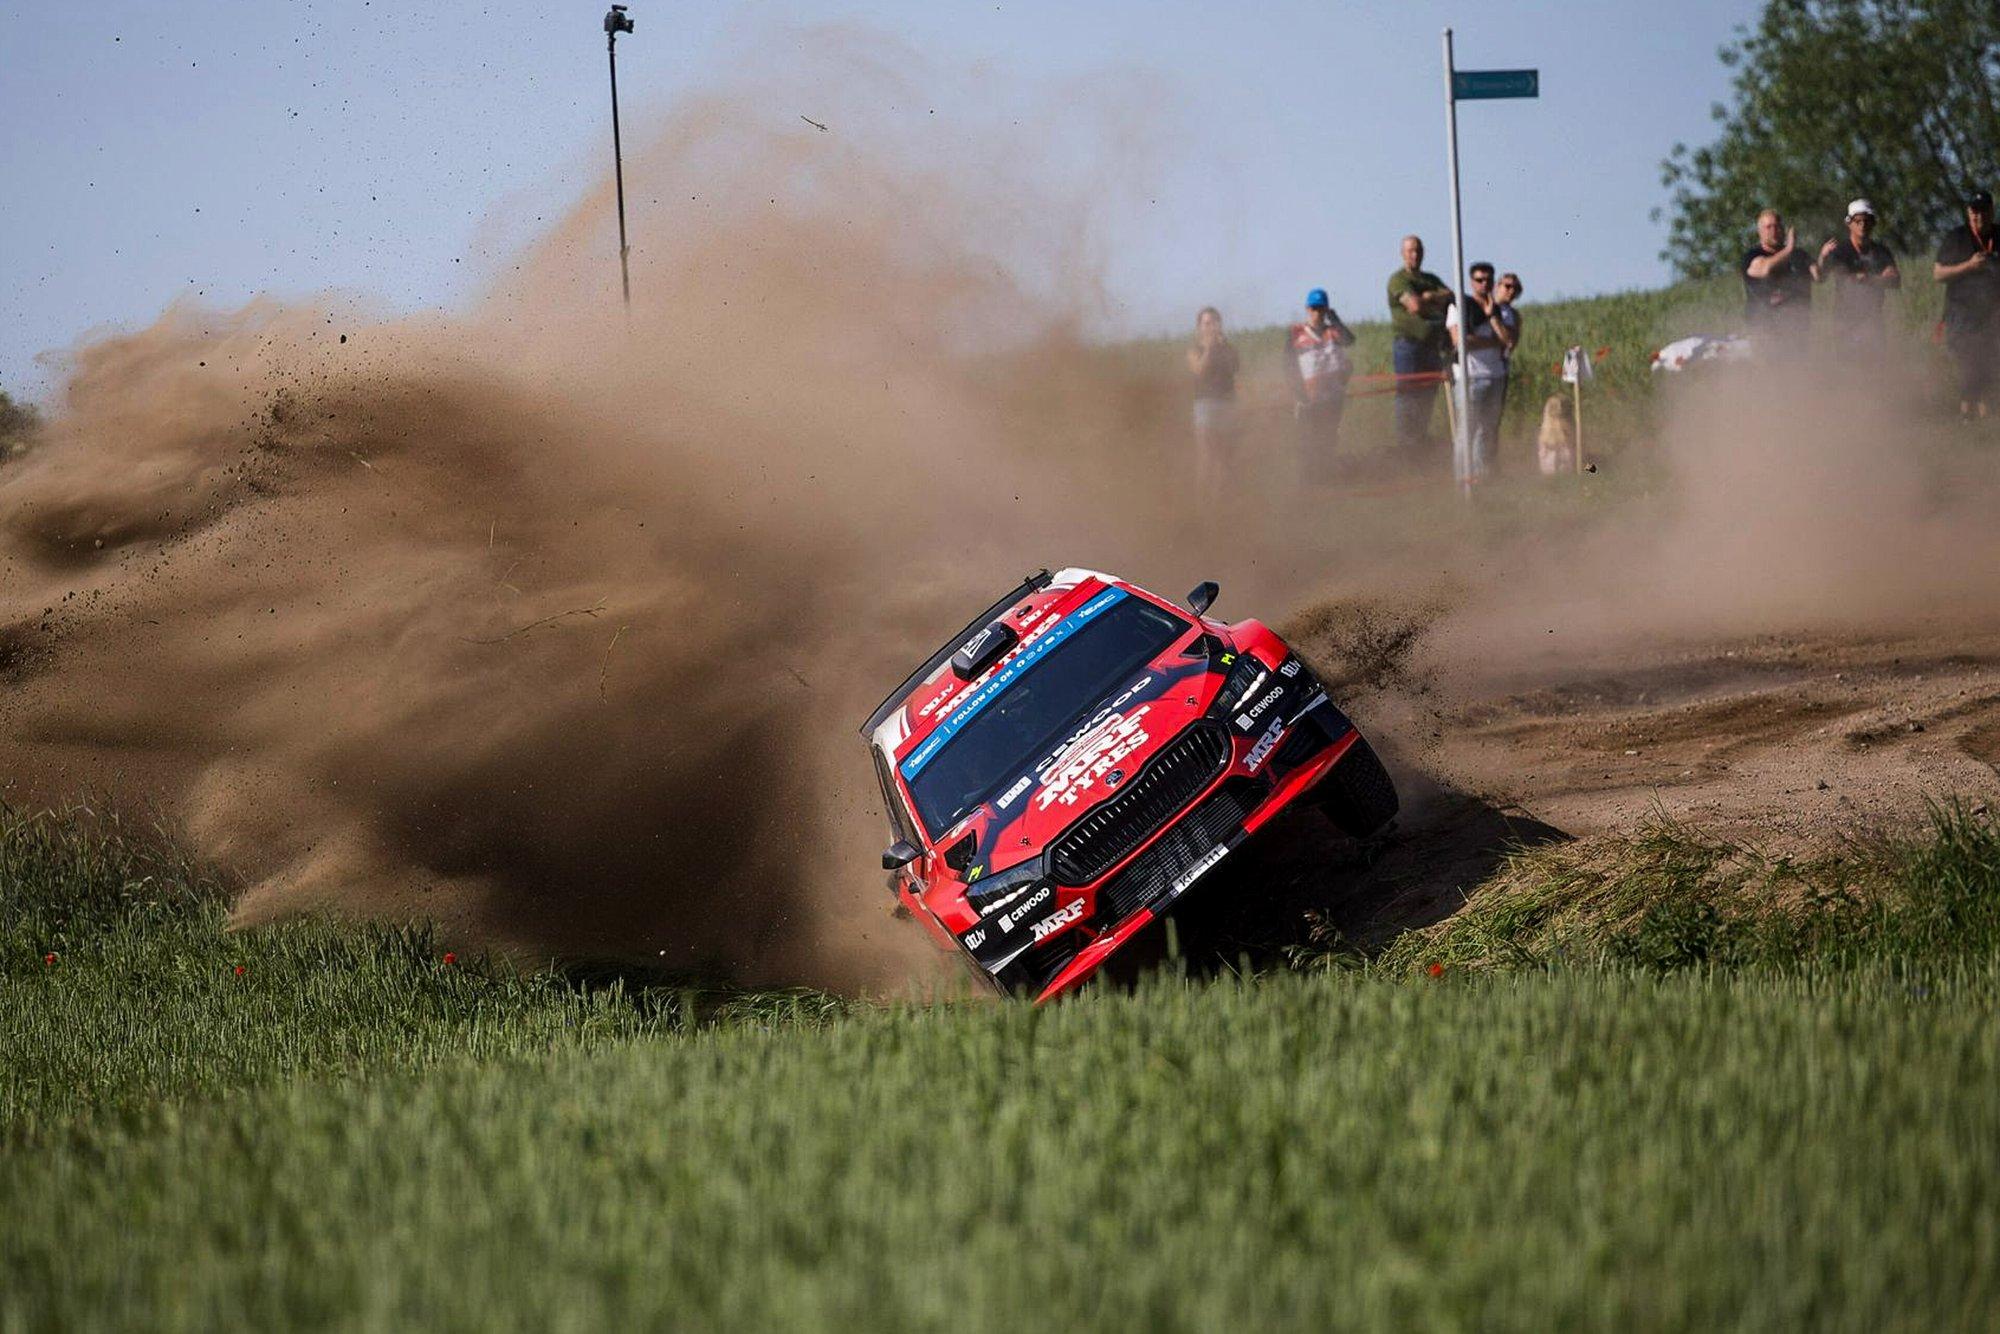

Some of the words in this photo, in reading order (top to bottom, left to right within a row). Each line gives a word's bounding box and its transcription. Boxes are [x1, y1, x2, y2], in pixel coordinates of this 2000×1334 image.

[934, 666, 996, 722] MRF
[998, 612, 1062, 665] TYRES
[952, 693, 987, 725] FOLLOW
[986, 682, 1000, 695] US
[1000, 670, 1014, 682] ON
[1035, 676, 1152, 773] CEWOOD
[1249, 686, 1285, 718] CEWOOD
[1035, 705, 1151, 811] MRF
[1058, 729, 1149, 806] TYRES
[1242, 716, 1286, 772] MRF
[1011, 887, 1050, 922] CEWOOD
[1029, 897, 1086, 942] MRF
